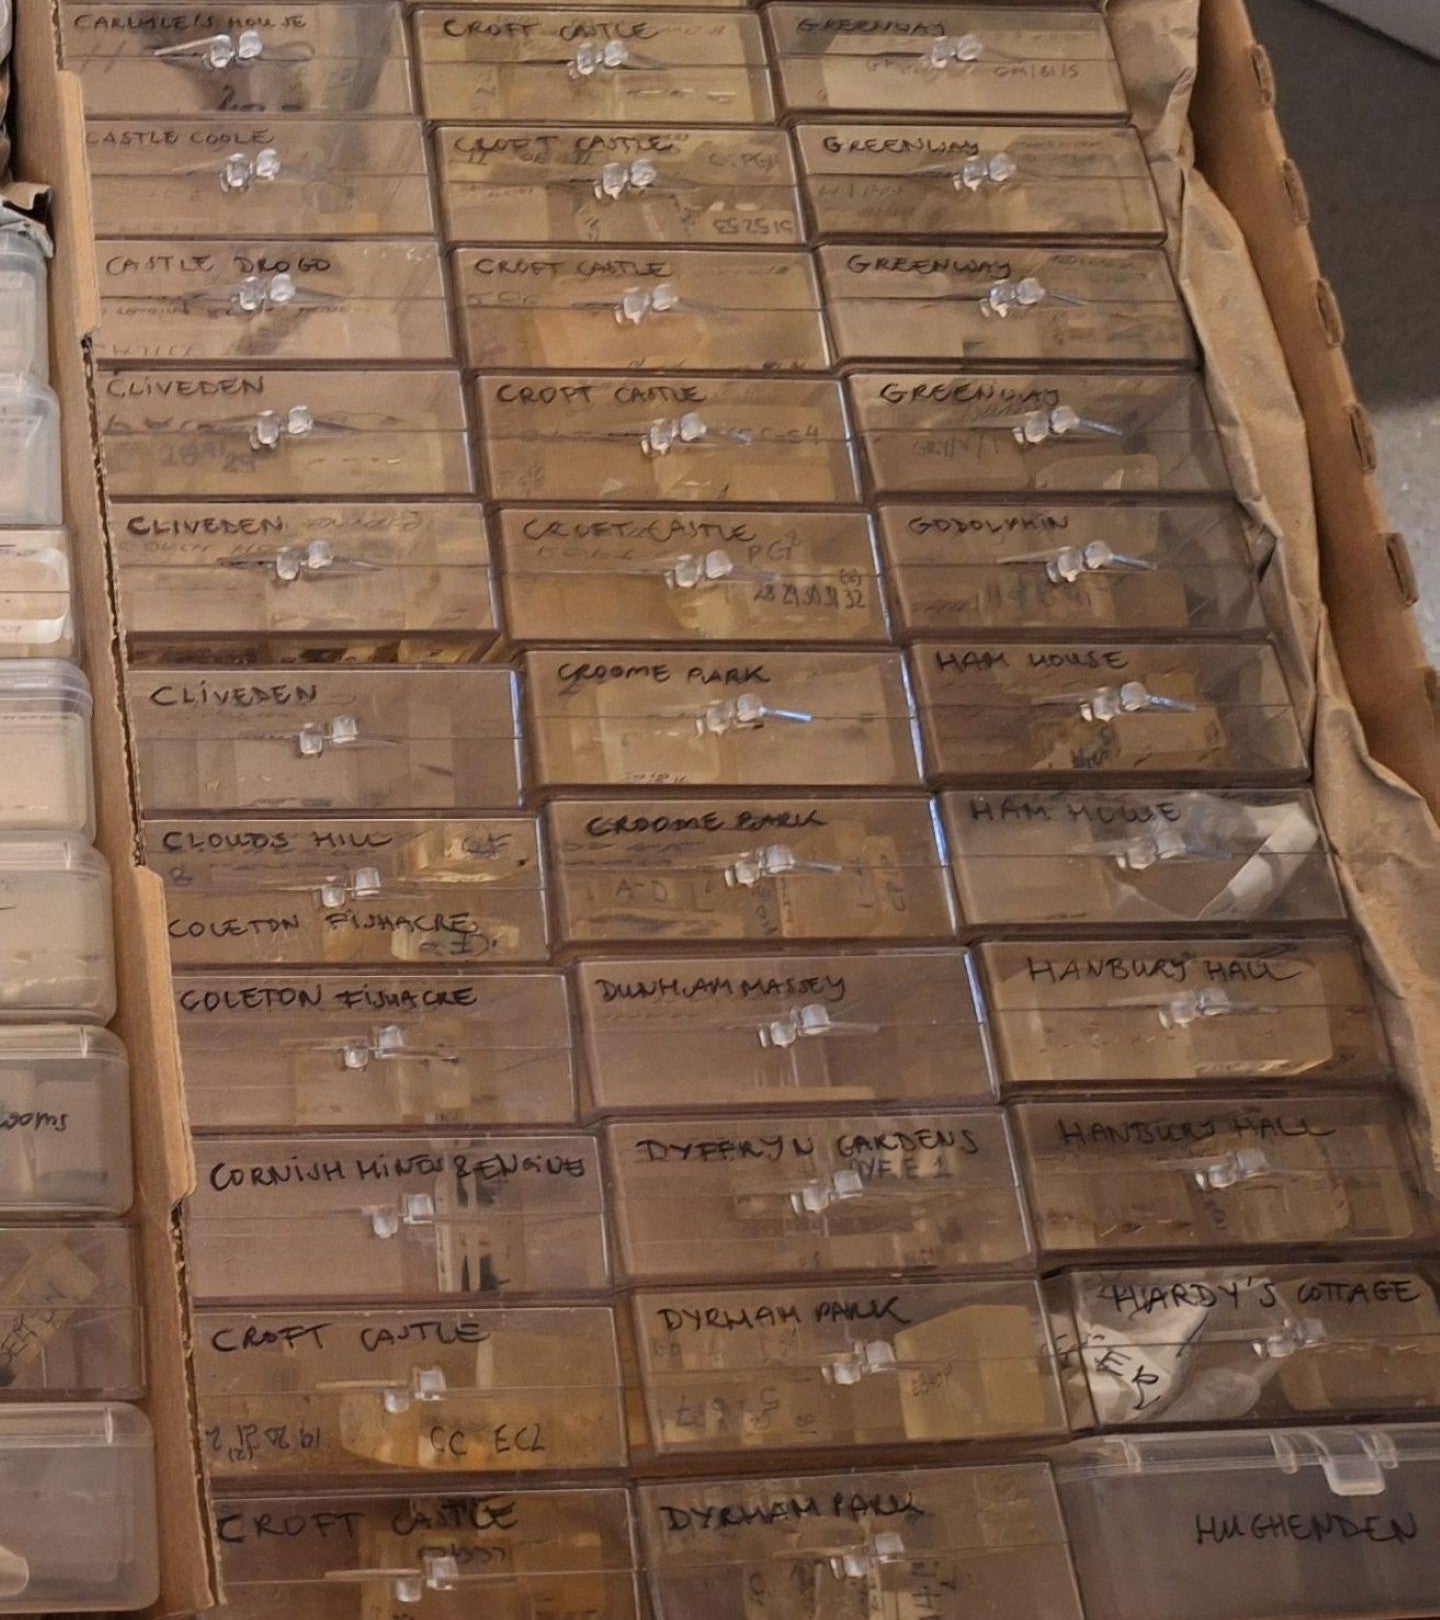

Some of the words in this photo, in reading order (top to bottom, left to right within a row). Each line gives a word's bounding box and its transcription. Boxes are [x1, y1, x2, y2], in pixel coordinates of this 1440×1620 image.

[442, 18, 543, 38] CROFT
[823, 136, 981, 157] GREENWAY
[105, 256, 216, 276] CASTLE
[234, 256, 332, 275] DROGO
[474, 257, 564, 278] CROFT
[846, 253, 1012, 279] GREENWAY
[106, 375, 266, 398] CLIVEDEN
[126, 515, 285, 537] CLIVEDEN
[557, 662, 671, 684] CROOME
[687, 665, 771, 685] PARK
[935, 651, 1009, 672] HAM
[149, 679, 318, 707] CLIVEDEN
[585, 811, 724, 837] CROOME
[969, 801, 1051, 822] HAM
[162, 831, 290, 851] CLOUDS
[168, 914, 301, 939] COLETON
[1027, 956, 1188, 984] HANBURY
[179, 984, 323, 1012] COLETON
[594, 978, 734, 1002] DUNHAM
[739, 975, 848, 1001] MASSEY
[836, 1128, 980, 1155] GARDENS
[209, 1155, 347, 1193] CORNISH
[1110, 1276, 1278, 1315] HARDY'S
[1297, 1279, 1421, 1304] COTTAGE
[657, 1307, 802, 1333] DYRHAM
[210, 1321, 333, 1353] CROFT
[360, 1321, 492, 1353] CASTLE
[216, 1511, 365, 1545] CROFT
[1194, 1511, 1420, 1545] HUGHENDEN
